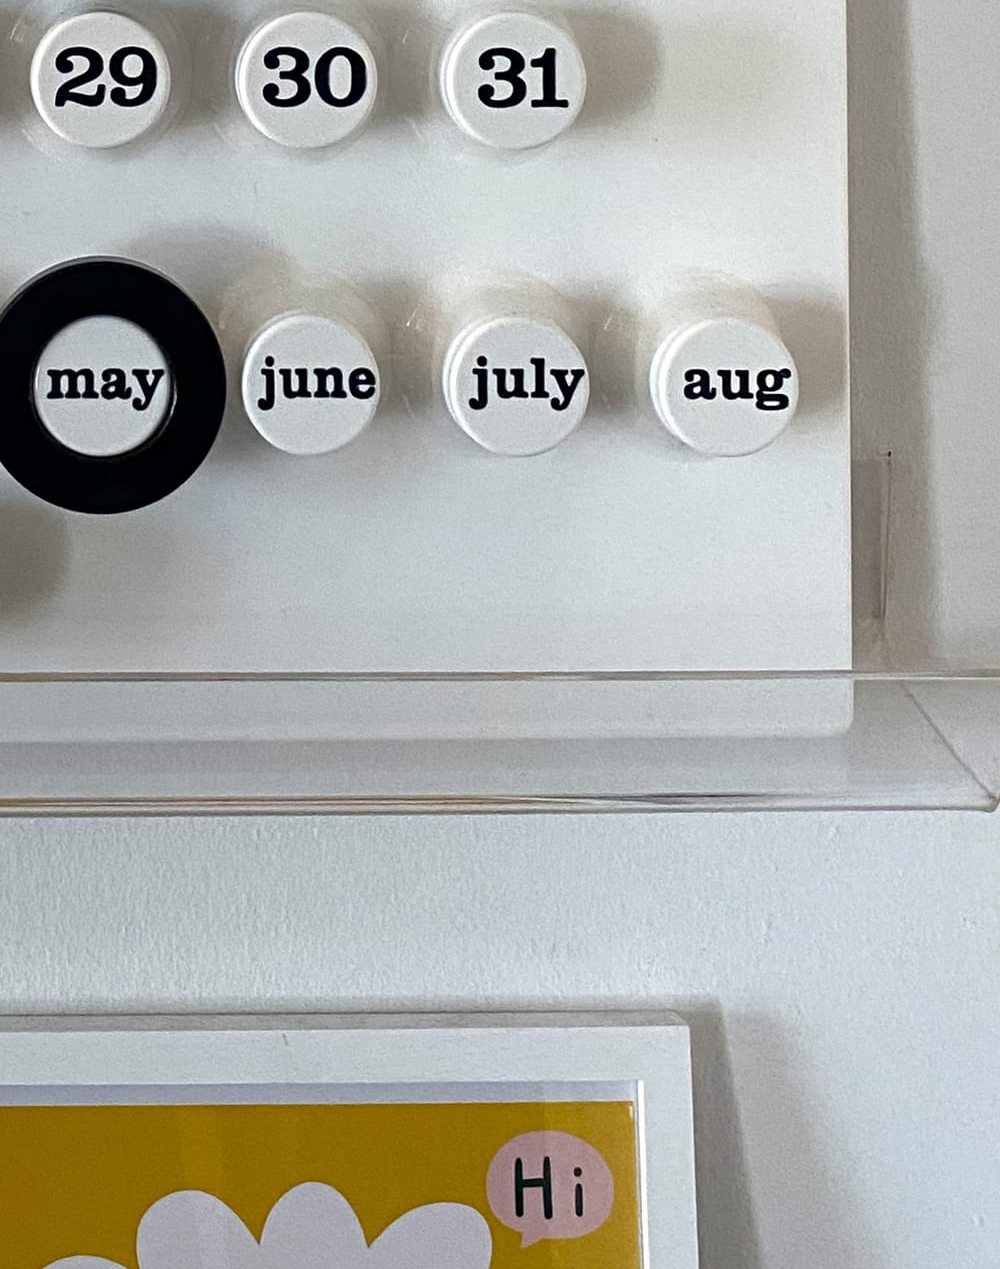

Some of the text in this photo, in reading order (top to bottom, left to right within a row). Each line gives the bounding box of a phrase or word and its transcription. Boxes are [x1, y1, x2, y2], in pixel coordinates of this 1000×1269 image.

[54, 46, 158, 108] 29
[262, 46, 367, 108] 30
[477, 47, 570, 109] 31
[46, 367, 165, 412] may
[256, 355, 378, 411] june
[468, 355, 586, 412] july
[683, 368, 792, 411] aug
[513, 1155, 584, 1221] Hi
